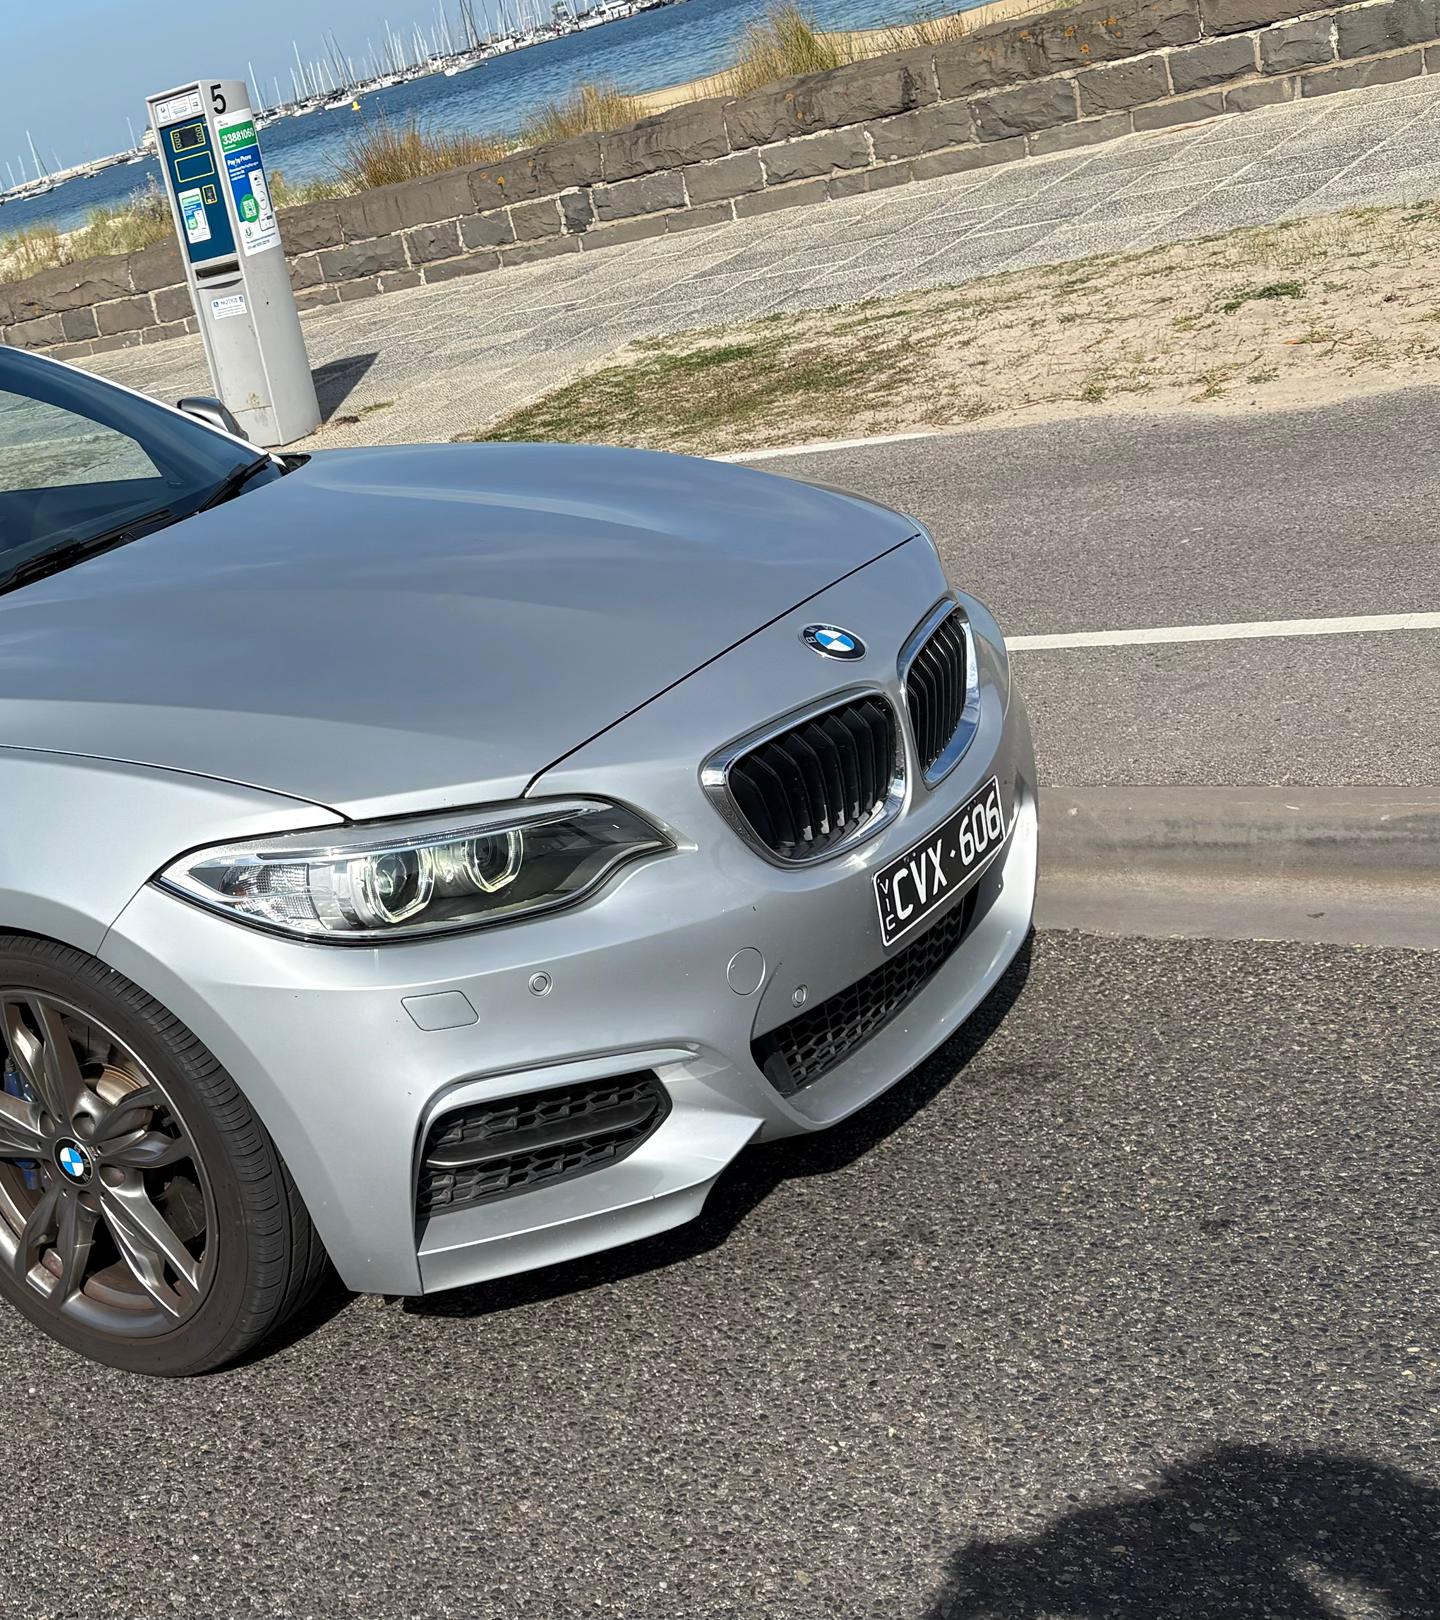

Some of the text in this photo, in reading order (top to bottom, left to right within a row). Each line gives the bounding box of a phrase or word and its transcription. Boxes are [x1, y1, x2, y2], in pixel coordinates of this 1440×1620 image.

[210, 84, 226, 115] 5
[892, 790, 1002, 921] CVX 606
[879, 879, 897, 931] VIC
